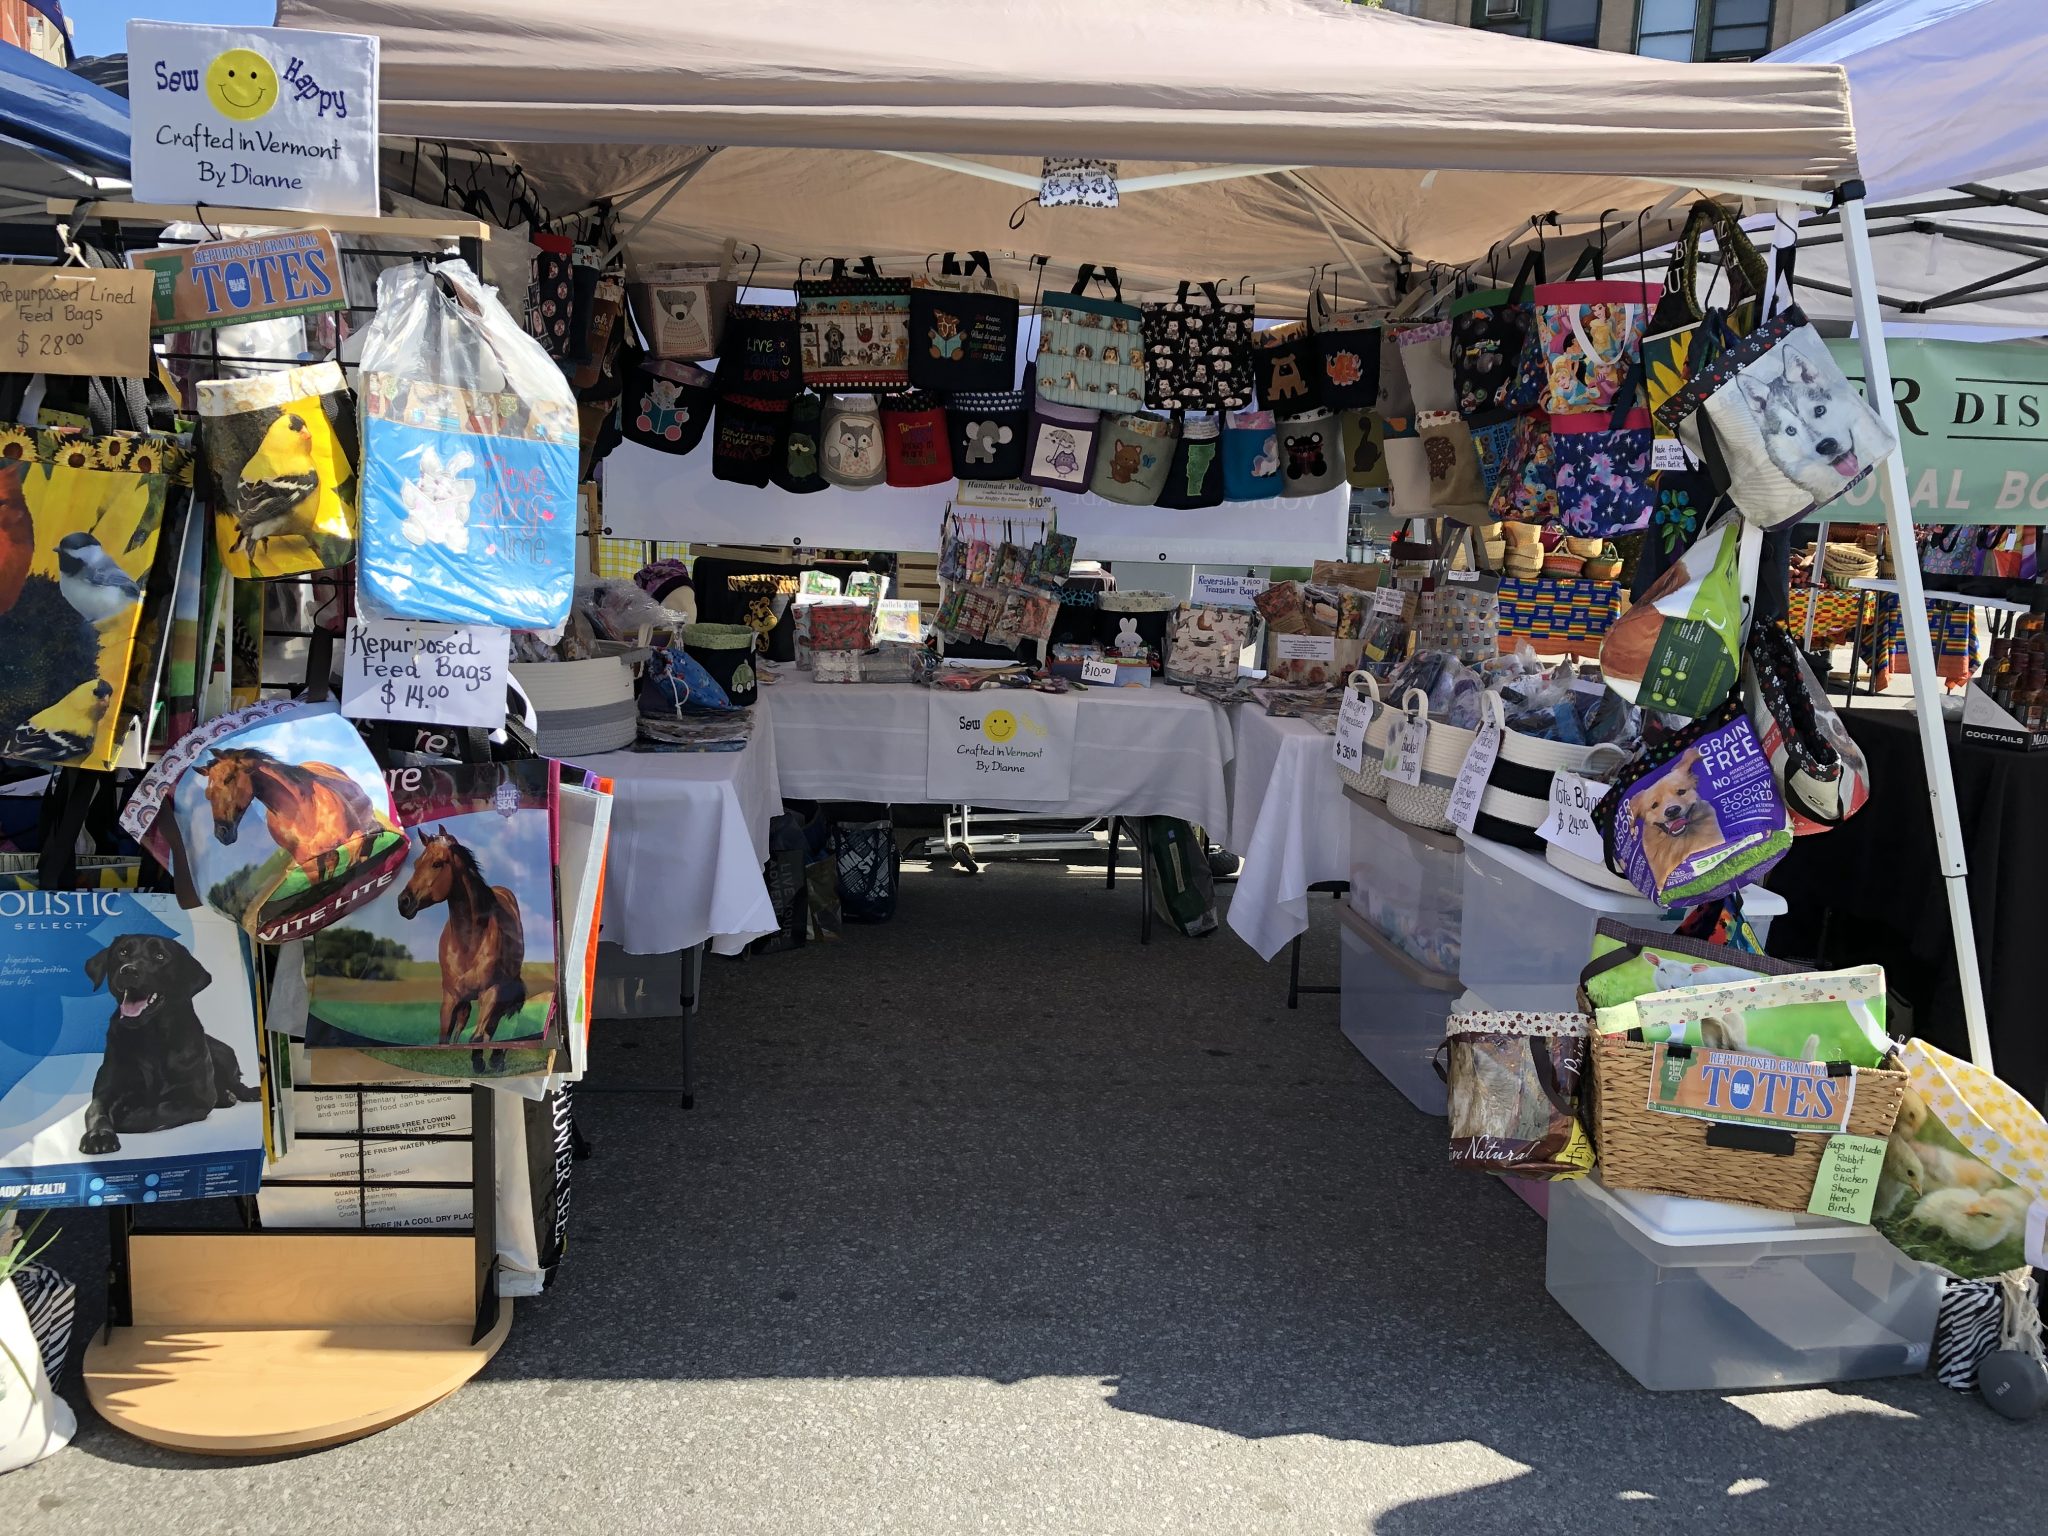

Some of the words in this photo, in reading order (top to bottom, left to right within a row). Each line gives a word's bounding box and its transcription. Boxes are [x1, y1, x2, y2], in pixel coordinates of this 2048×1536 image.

[154, 60, 199, 92] Sew
[283, 57, 347, 118] Happy
[156, 123, 233, 153] Crafted
[239, 132, 255, 151] in
[255, 131, 341, 159] Vermont
[197, 160, 226, 188] By
[230, 162, 303, 189] Dianne
[194, 240, 261, 264] REPURPOSED
[263, 236, 296, 252] GRAIN
[298, 233, 318, 248] BAG
[191, 249, 332, 313] TOTES
[228, 277, 245, 286] BLUE
[0, 281, 79, 310] Repurposed
[91, 285, 136, 304] Lined
[20, 305, 53, 322] Feed
[64, 305, 103, 330] Bags
[17, 330, 29, 357] $
[747, 338, 774, 352] LIVE
[967, 481, 1006, 490] Handmade
[1008, 482, 1033, 491] Wallets
[1198, 575, 1239, 586] Reversible
[1205, 585, 1236, 595] Treasure
[1239, 586, 1259, 599] Bags
[363, 657, 419, 678] Feed
[435, 657, 492, 691] Bags
[1083, 662, 1111, 677] $10.00
[381, 680, 395, 713] $
[959, 716, 981, 730] Sew
[1698, 721, 1750, 757] GRAIN
[1966, 731, 2024, 745] COCKTAILS
[956, 744, 995, 757] Crafted
[996, 746, 1005, 756] in
[1005, 747, 1043, 758] Vermont
[1702, 735, 1759, 776] FREE
[976, 760, 990, 773] By
[992, 761, 1025, 773] Dianne
[1712, 776, 1731, 790] NO
[497, 790, 517, 800] BLUE
[1556, 778, 1572, 807] Tote
[1720, 779, 1771, 806] SLOOOW
[497, 800, 517, 810] SEAL
[1723, 790, 1773, 814] COOKED
[1556, 809, 1564, 835] $
[781, 863, 796, 896] LIVE
[258, 907, 326, 941] VITE
[335, 872, 393, 908] LITE
[15, 922, 83, 930] SELECT
[782, 904, 793, 939] YOUR
[1709, 1052, 1777, 1071] REPURPOSED
[1778, 1060, 1812, 1075] GRAIN
[1814, 1065, 1828, 1076] BA
[1702, 1065, 1837, 1119] TOTES
[1733, 1082, 1750, 1090] BLUE
[314, 1094, 334, 1102] birds
[316, 1102, 336, 1111] gives
[334, 1109, 357, 1117] winter
[367, 1124, 401, 1133] FEEDERS
[422, 1114, 456, 1124] FLOWING
[405, 1125, 426, 1134] THEM
[426, 1122, 451, 1130] OFTEN
[339, 1150, 373, 1159] PROVDE
[373, 1146, 398, 1155] FRESH
[399, 1141, 425, 1151] WATER
[1465, 1134, 1541, 1161] Natural
[1849, 1144, 1882, 1156] include
[1836, 1153, 1865, 1165] Rabbit
[1834, 1164, 1859, 1173] Goat
[1832, 1173, 1868, 1184] Chicken
[30, 1182, 67, 1196] HEALTH
[1831, 1183, 1860, 1198] Sheep
[1829, 1193, 1847, 1202] Hen
[1827, 1202, 1856, 1215] Birds
[411, 1217, 434, 1225] COOL
[435, 1214, 452, 1222] DRY
